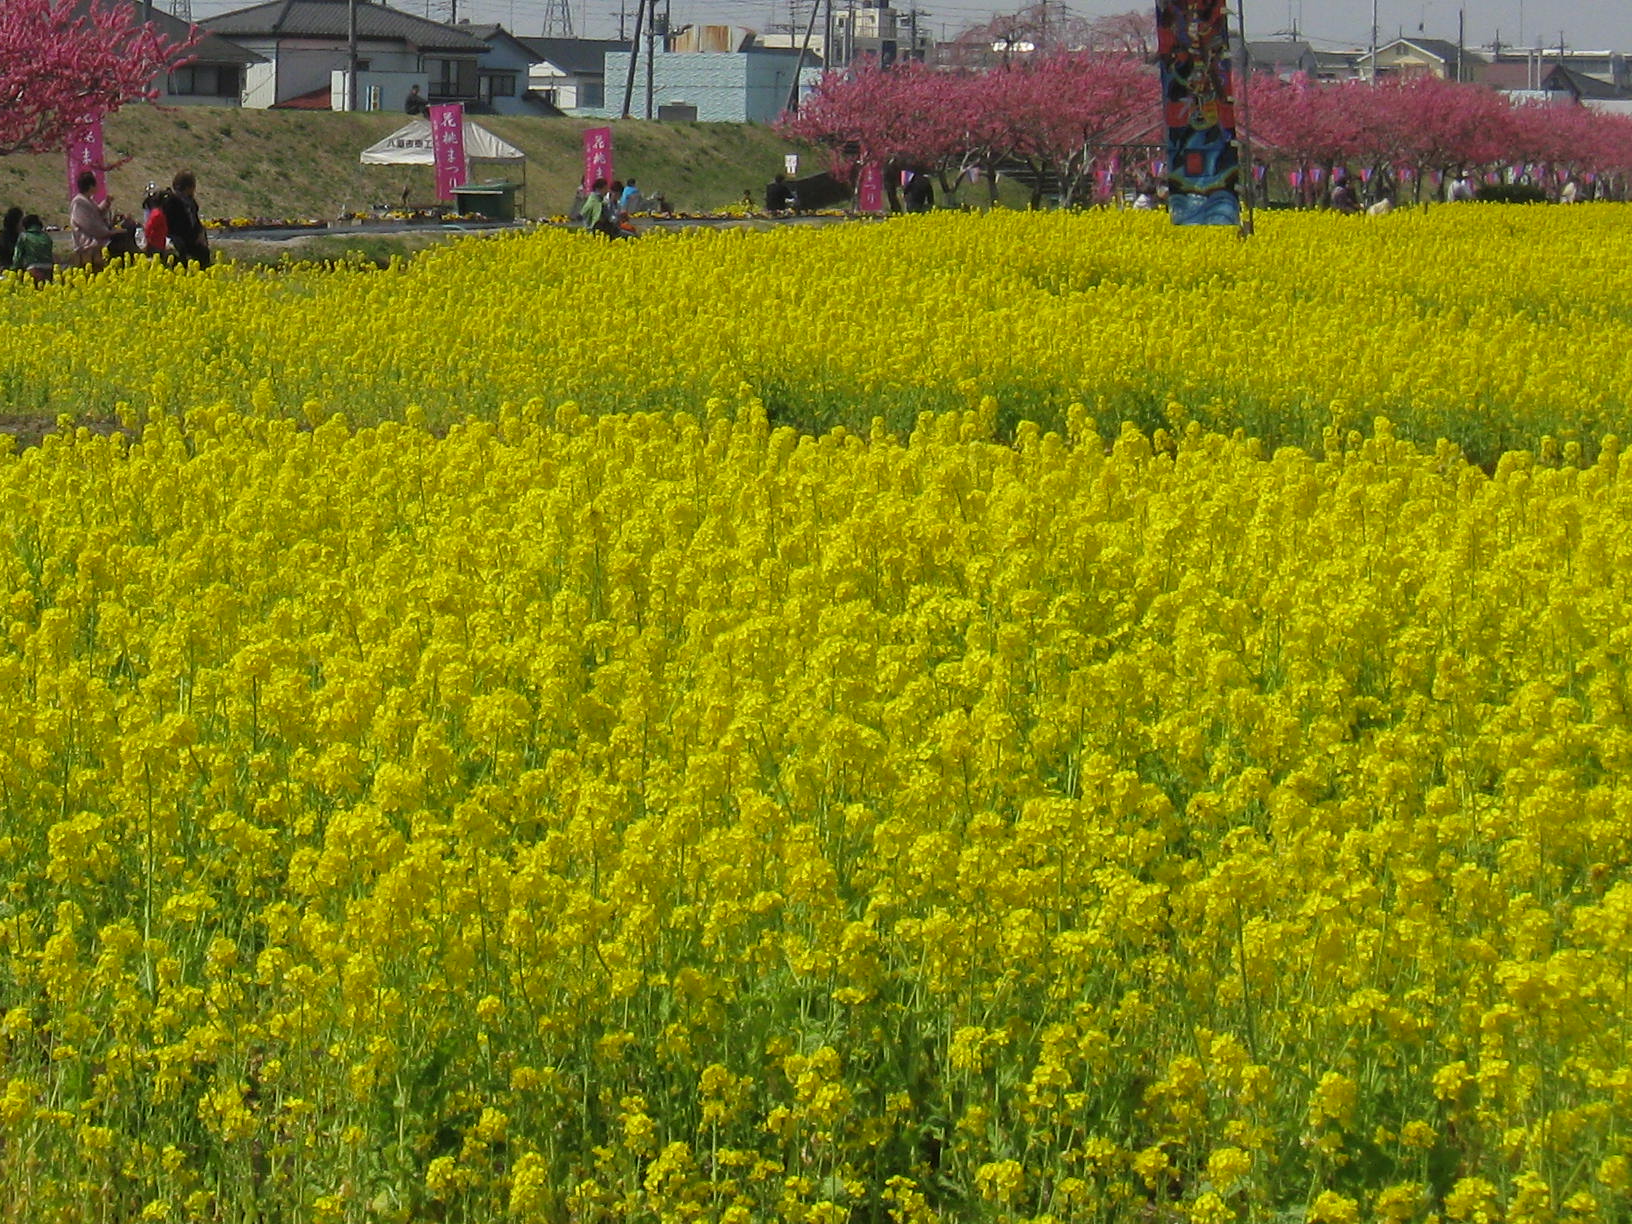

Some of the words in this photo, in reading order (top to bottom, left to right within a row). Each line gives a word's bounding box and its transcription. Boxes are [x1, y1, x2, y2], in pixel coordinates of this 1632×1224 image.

[440, 110, 460, 188] 花桃まつり
